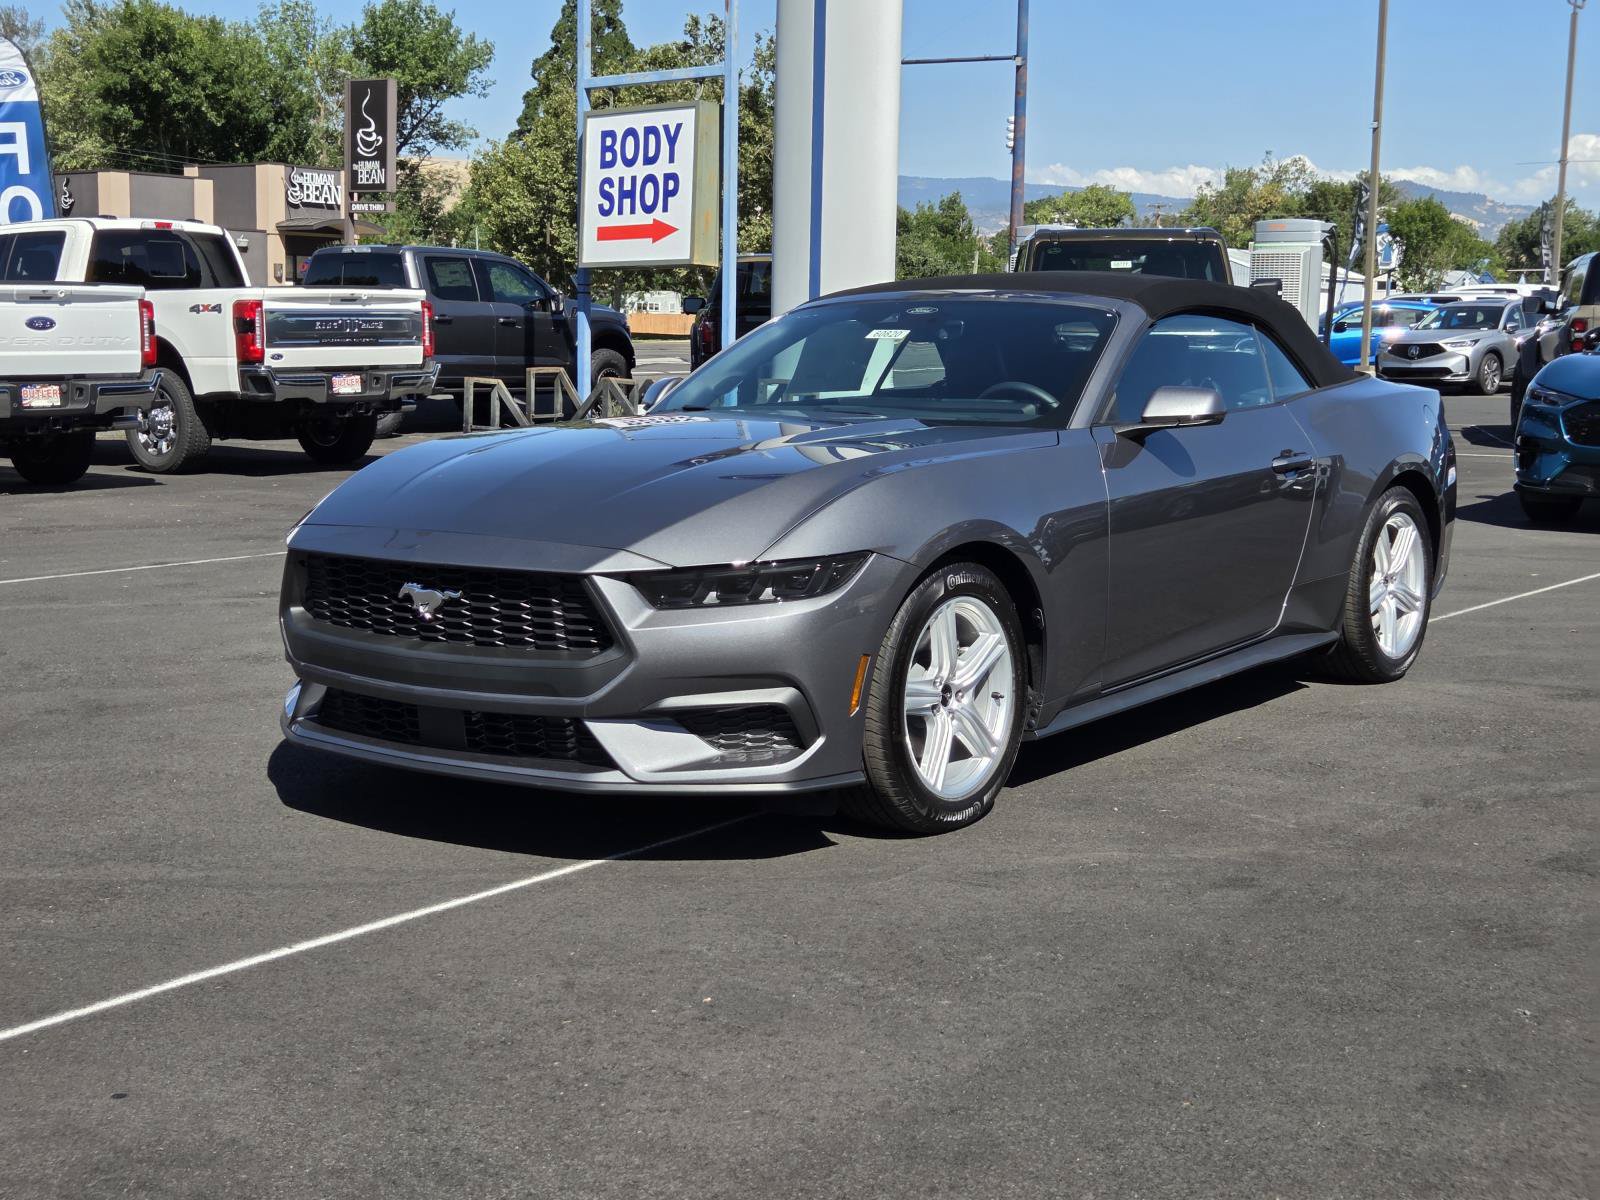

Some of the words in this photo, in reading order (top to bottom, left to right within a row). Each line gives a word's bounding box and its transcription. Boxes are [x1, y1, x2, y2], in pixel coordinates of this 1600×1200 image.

[600, 122, 683, 170] BODY
[358, 160, 380, 170] HUMAN
[302, 172, 335, 186] HUMAN
[358, 168, 385, 184] BEAN
[302, 184, 342, 205] BEAN
[597, 172, 680, 217] SHOP
[352, 203, 369, 211] DRIVE
[369, 203, 385, 211] THRU
[57, 336, 132, 346] DUTY
[22, 388, 60, 400] BUTLER
